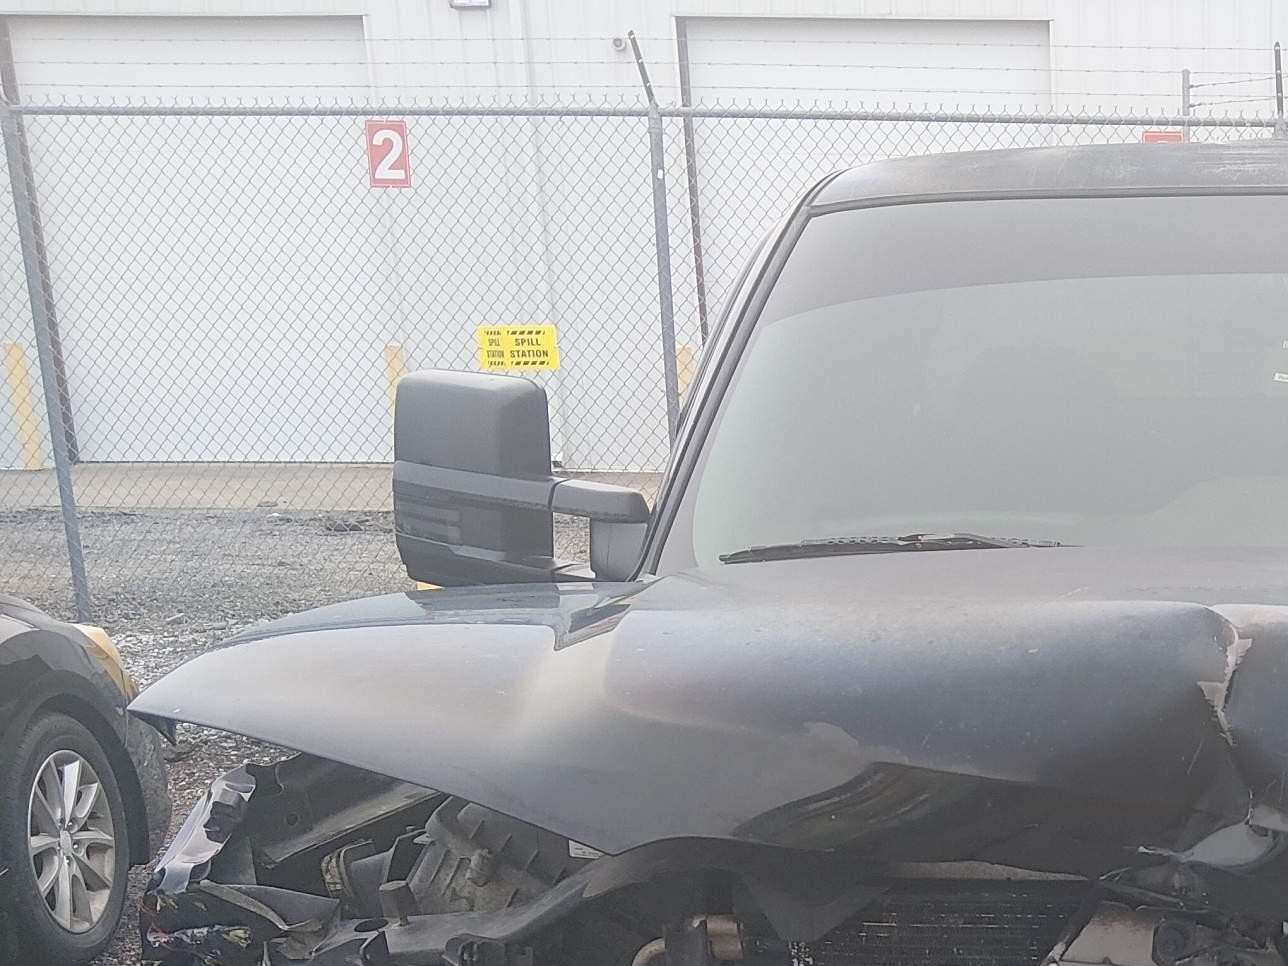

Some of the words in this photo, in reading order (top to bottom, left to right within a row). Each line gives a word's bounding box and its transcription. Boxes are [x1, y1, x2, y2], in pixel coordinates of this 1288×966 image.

[371, 129, 406, 180] 2
[514, 337, 542, 347] SPILL
[510, 349, 549, 358] STATION
